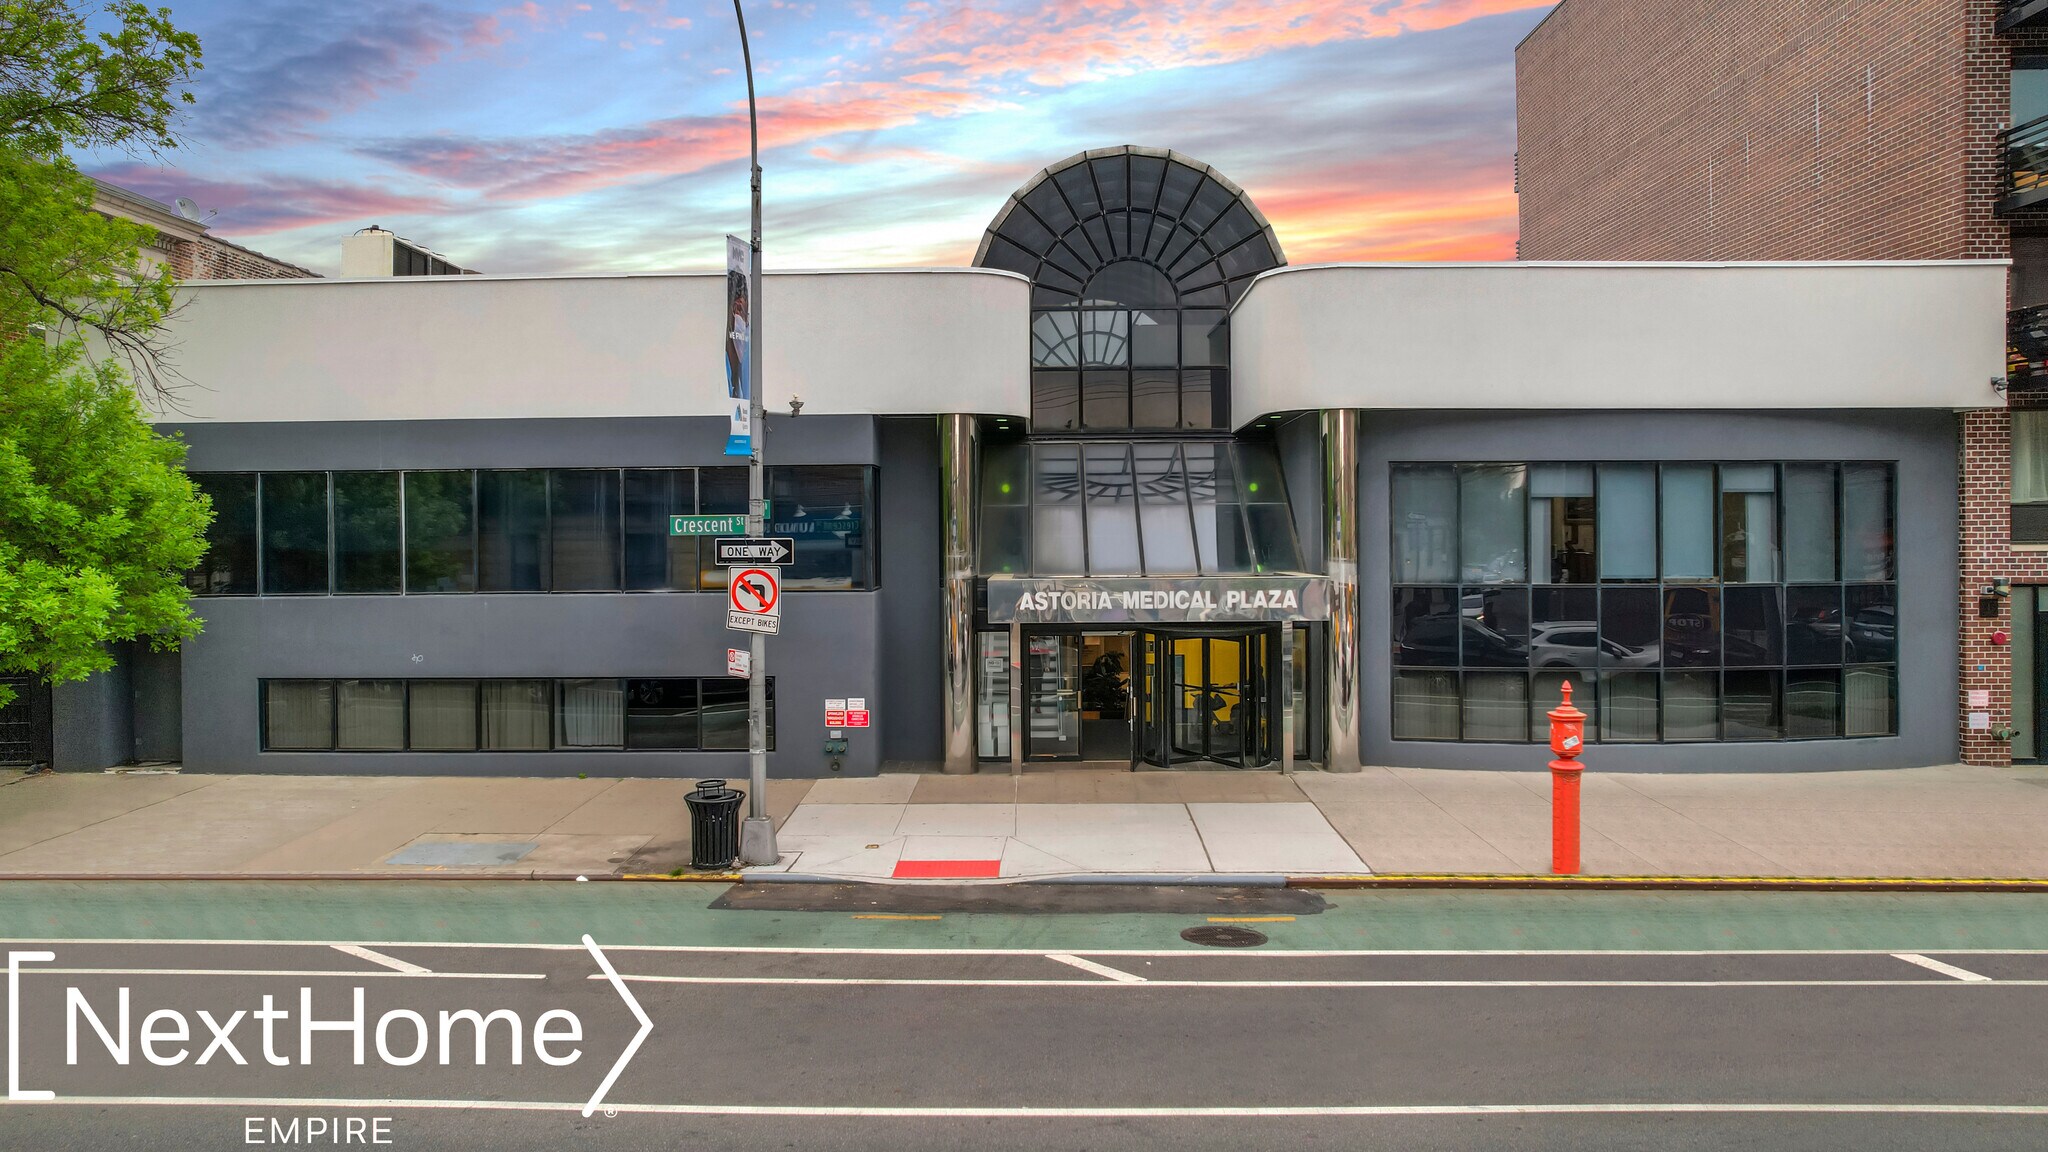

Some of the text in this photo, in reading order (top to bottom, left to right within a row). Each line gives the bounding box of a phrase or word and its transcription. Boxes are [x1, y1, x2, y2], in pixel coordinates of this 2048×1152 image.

[674, 516, 744, 533] Crescent St
[727, 546, 781, 557] ONE WAY
[1019, 589, 1298, 611] ASTORIA MEDICAL PLAZA
[729, 615, 777, 629] EXCEPT BIKES
